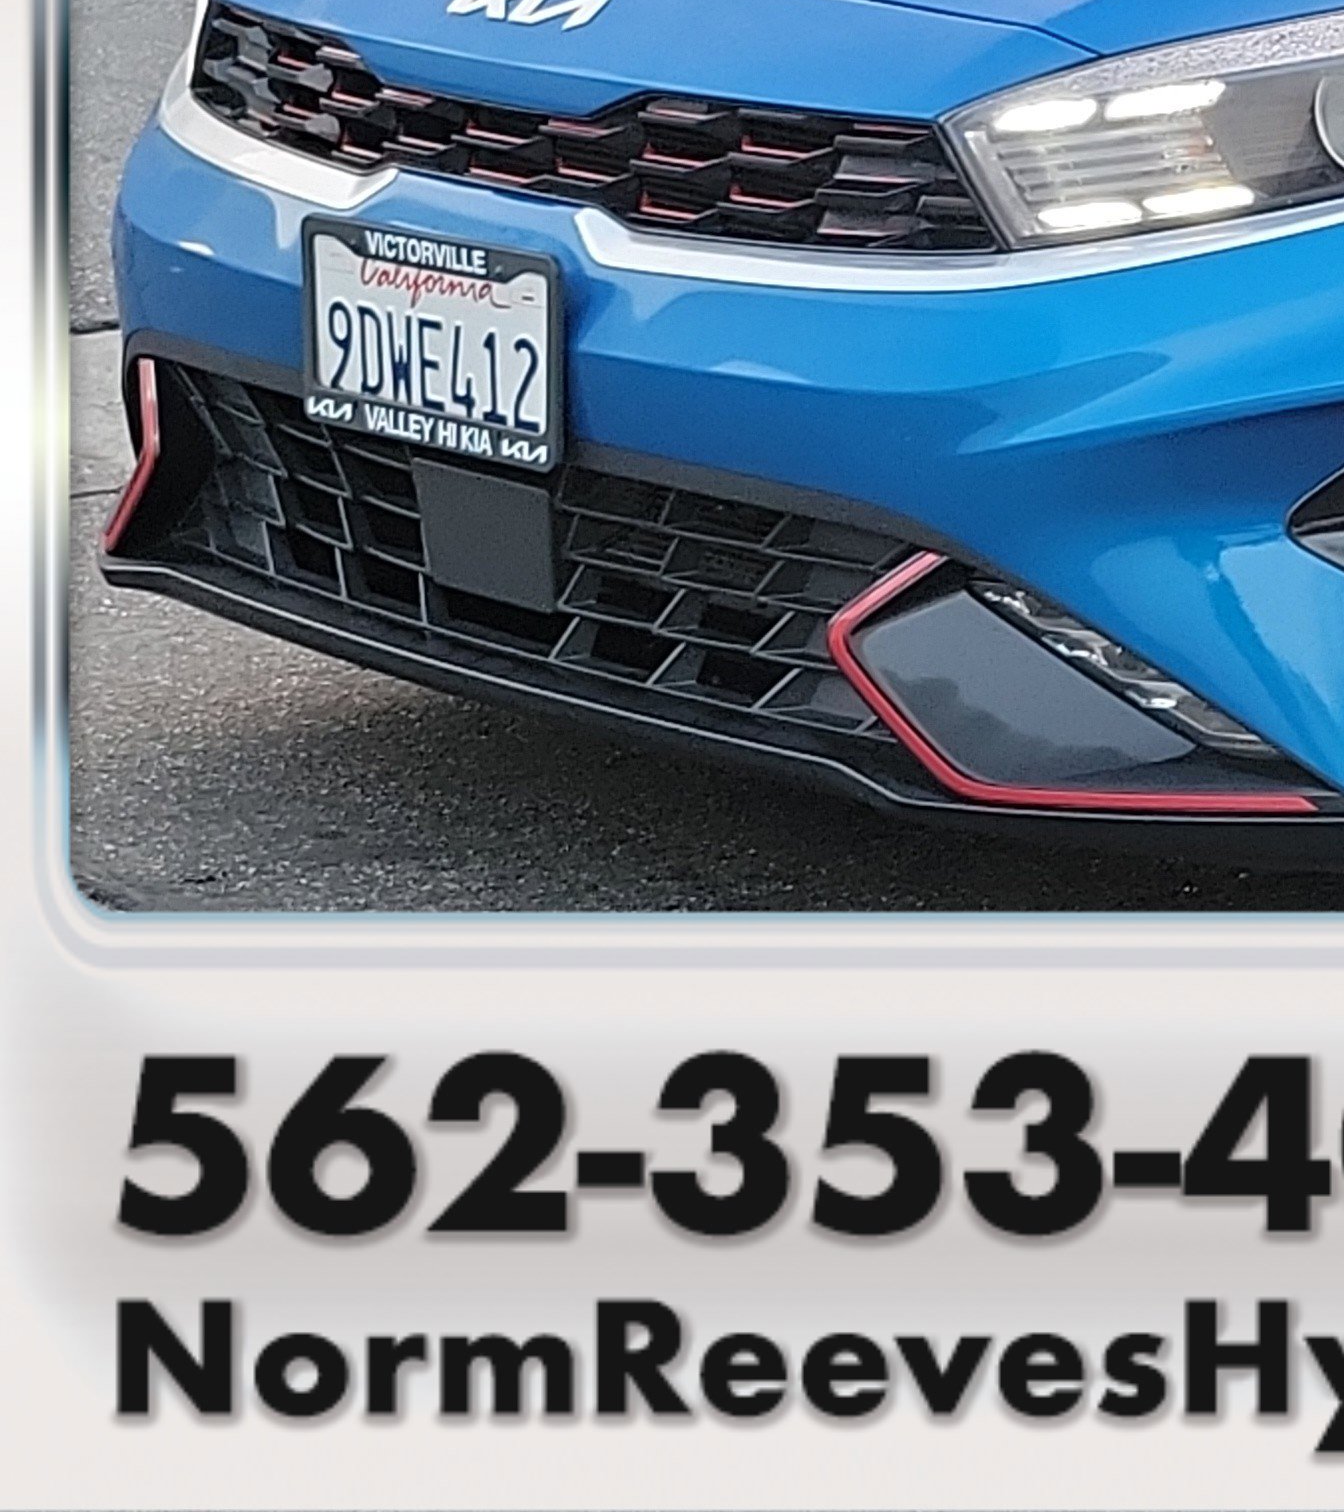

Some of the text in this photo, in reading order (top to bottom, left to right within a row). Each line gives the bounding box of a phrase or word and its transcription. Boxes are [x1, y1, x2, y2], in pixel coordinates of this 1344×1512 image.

[364, 229, 488, 276] VICTORVILLE
[360, 256, 511, 309] California
[328, 300, 541, 434] 9DWE412
[364, 403, 434, 444] VALLEY
[437, 419, 457, 449] HI
[460, 424, 494, 457] KIA
